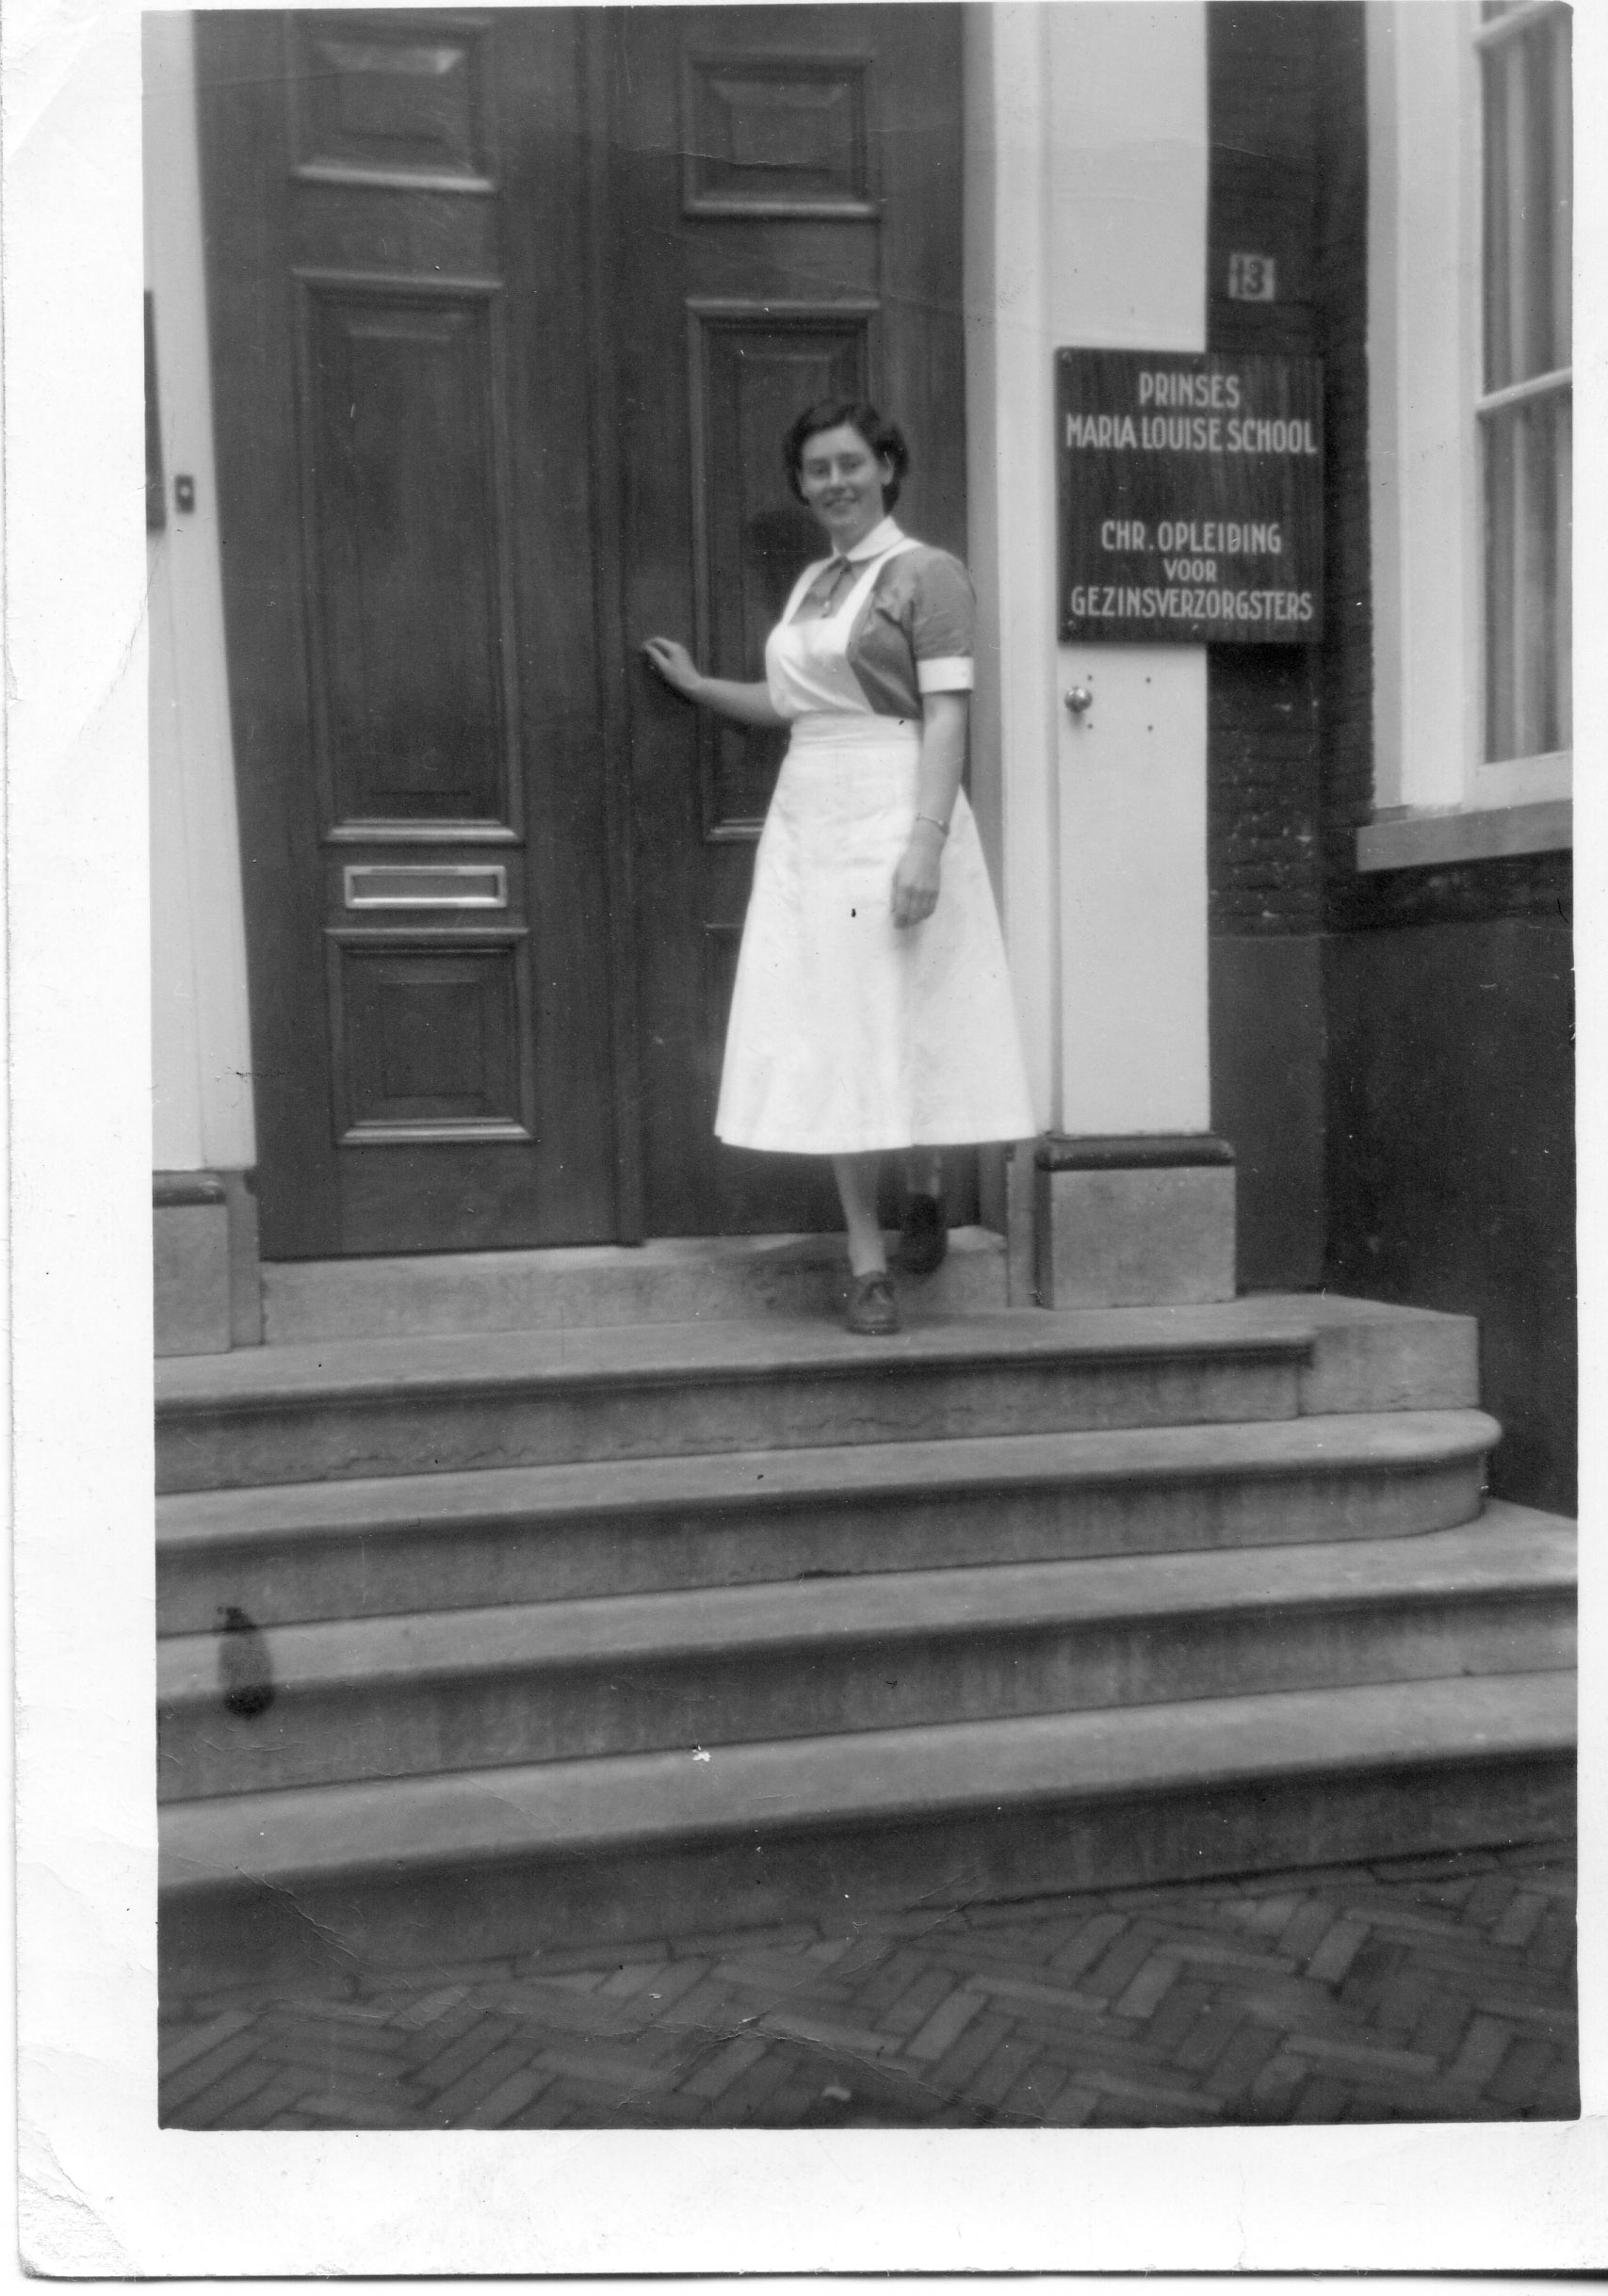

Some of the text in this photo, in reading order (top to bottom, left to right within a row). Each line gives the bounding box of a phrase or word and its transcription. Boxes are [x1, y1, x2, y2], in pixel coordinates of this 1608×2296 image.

[1139, 371, 1241, 409] PRINSES
[1066, 413, 1317, 454] MARIA LOUISE SCHOOL
[1101, 521, 1282, 554] CHR. OPLEIDING
[1163, 558, 1217, 582] VOOR
[1070, 586, 1312, 621] GEZINSVERZORGSTERS
